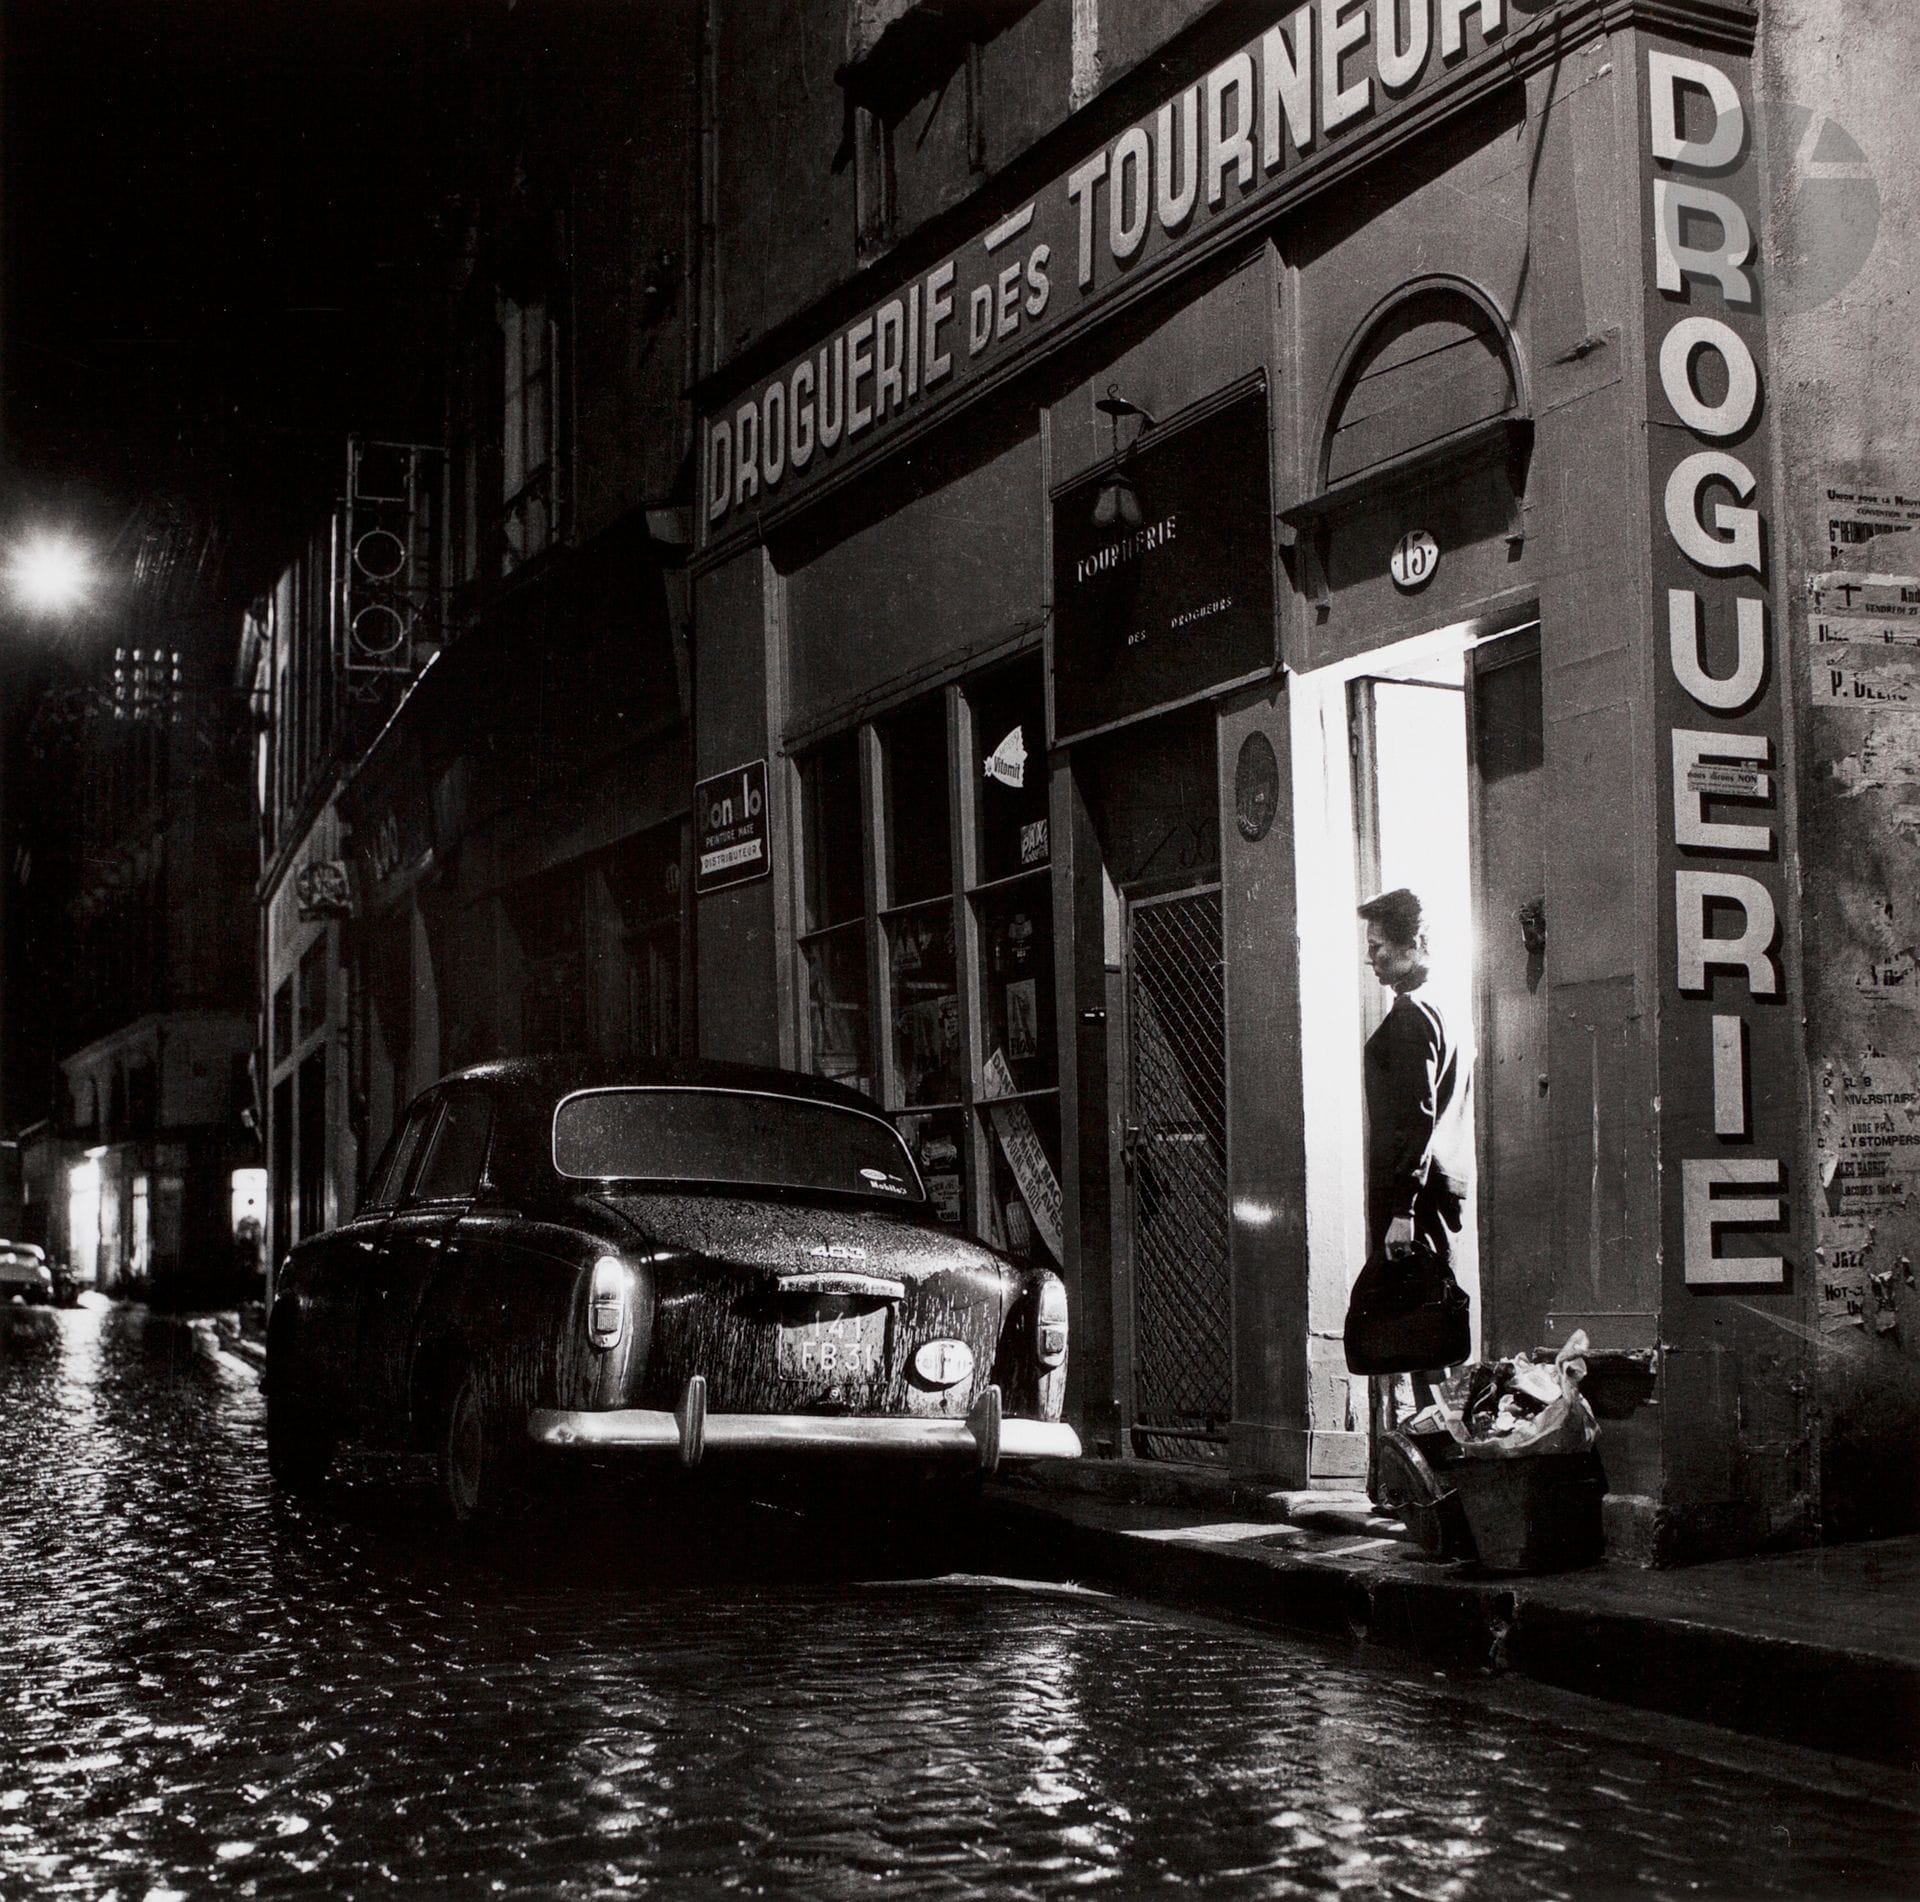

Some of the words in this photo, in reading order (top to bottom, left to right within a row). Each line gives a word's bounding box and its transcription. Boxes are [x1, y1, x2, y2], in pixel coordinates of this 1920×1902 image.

[709, 260, 956, 522] DROGUERIE
[970, 244, 1051, 357] DES
[1400, 529, 1428, 580] 15
[1128, 630, 1146, 646] DES
[1648, 50, 1786, 1285] DROGUERIE
[704, 844, 757, 869] DISTRIBUTEUR
[1859, 1135, 1920, 1148] STOMPERS
